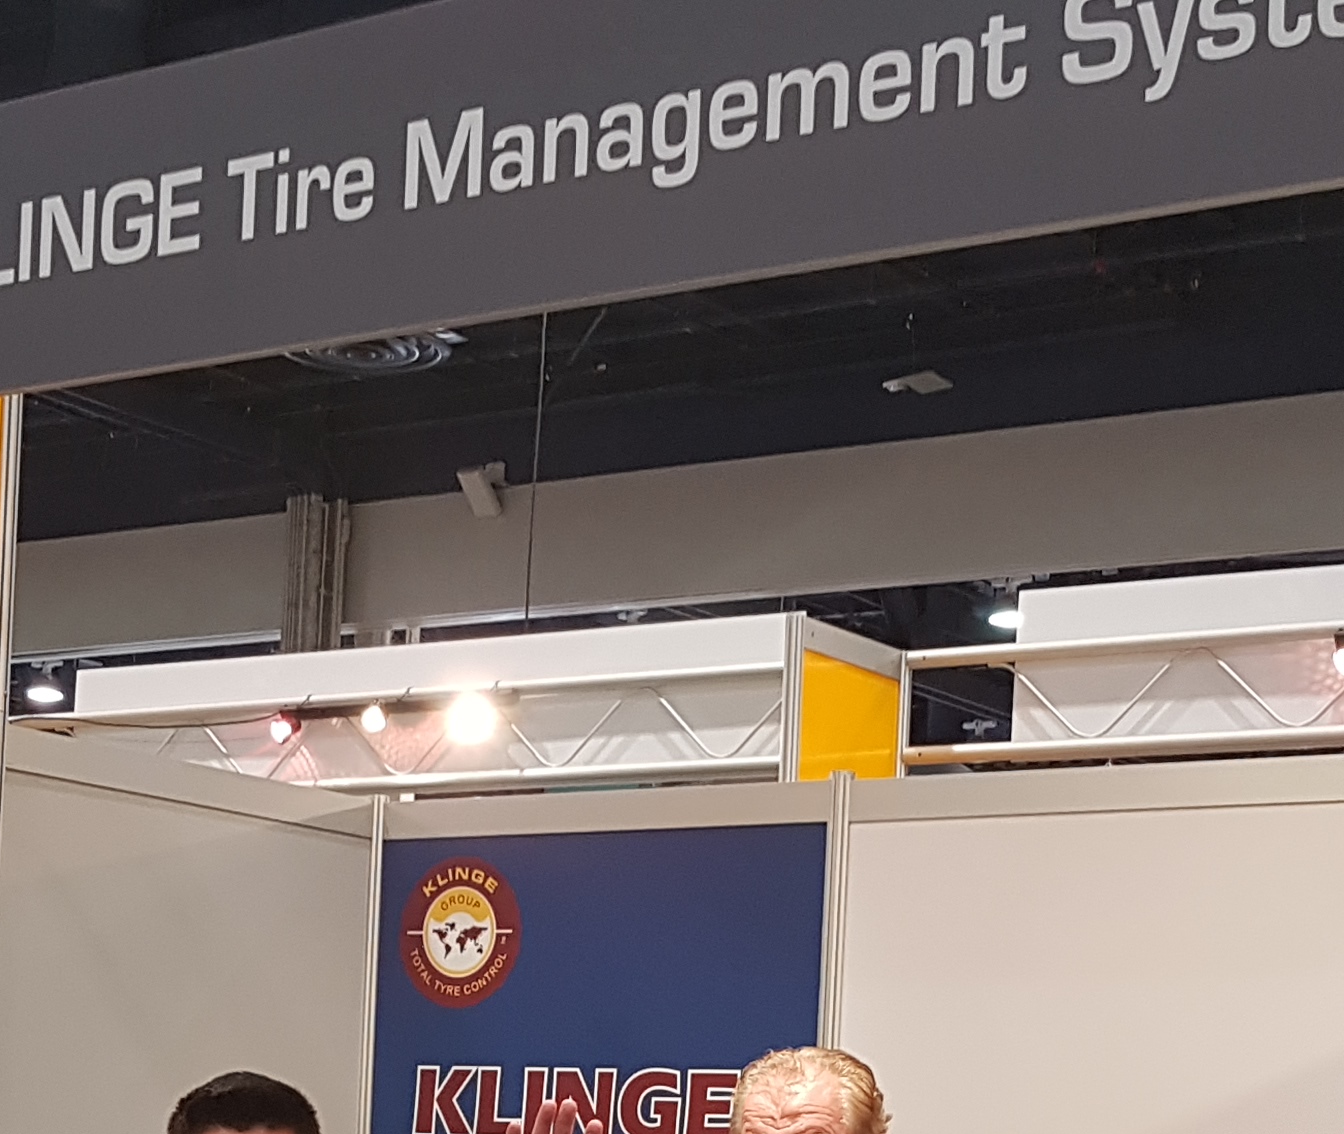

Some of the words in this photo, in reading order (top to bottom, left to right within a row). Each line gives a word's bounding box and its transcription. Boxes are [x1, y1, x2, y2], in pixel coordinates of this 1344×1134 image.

[228, 148, 376, 243] Tire
[403, 12, 1029, 208] Management
[422, 866, 499, 898] KLINGE
[440, 894, 481, 911] GROUP
[409, 947, 432, 986] TOTAL
[433, 979, 461, 997] TYRE
[463, 952, 508, 995] CONTROL
